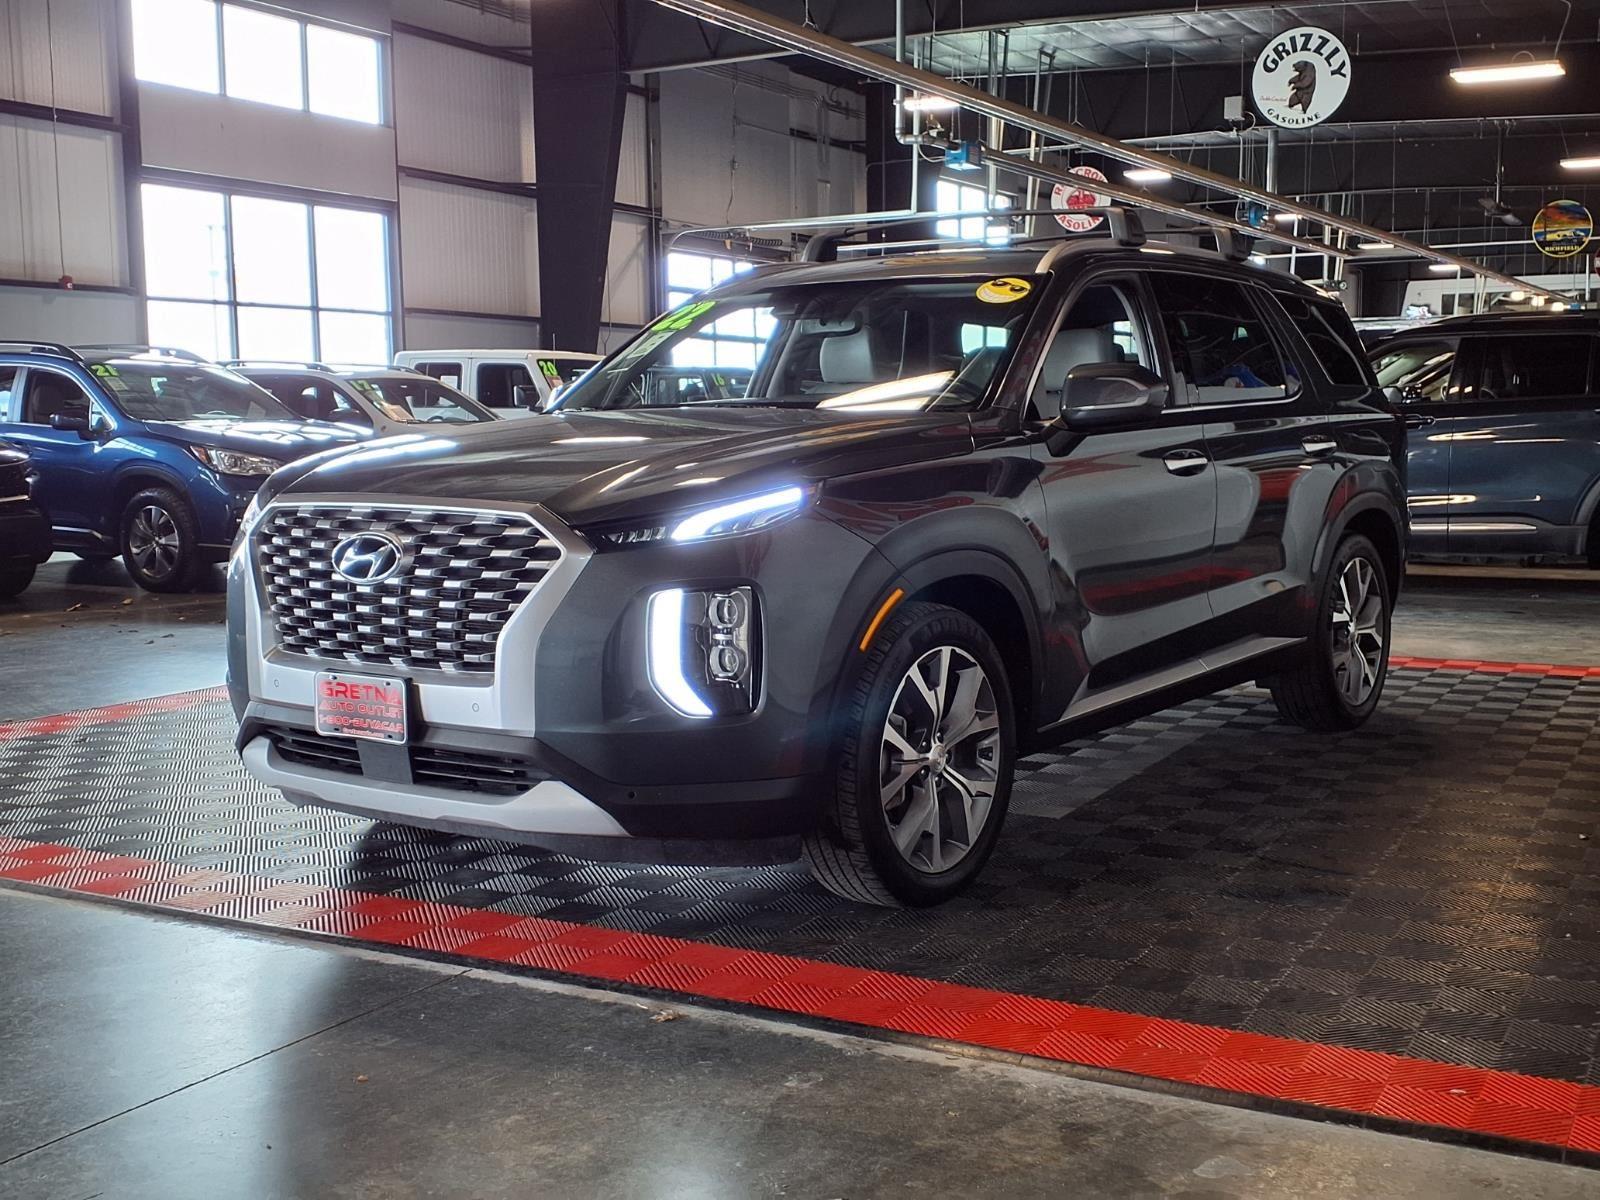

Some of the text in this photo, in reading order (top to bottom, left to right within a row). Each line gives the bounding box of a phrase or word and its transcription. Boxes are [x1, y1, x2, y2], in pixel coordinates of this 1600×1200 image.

[1263, 33, 1347, 79] GRIZZLY
[1267, 108, 1321, 125] GASOLINE
[539, 361, 558, 376] 20
[321, 681, 402, 704] GRETNA
[319, 700, 402, 718] AUTO OUTLET
